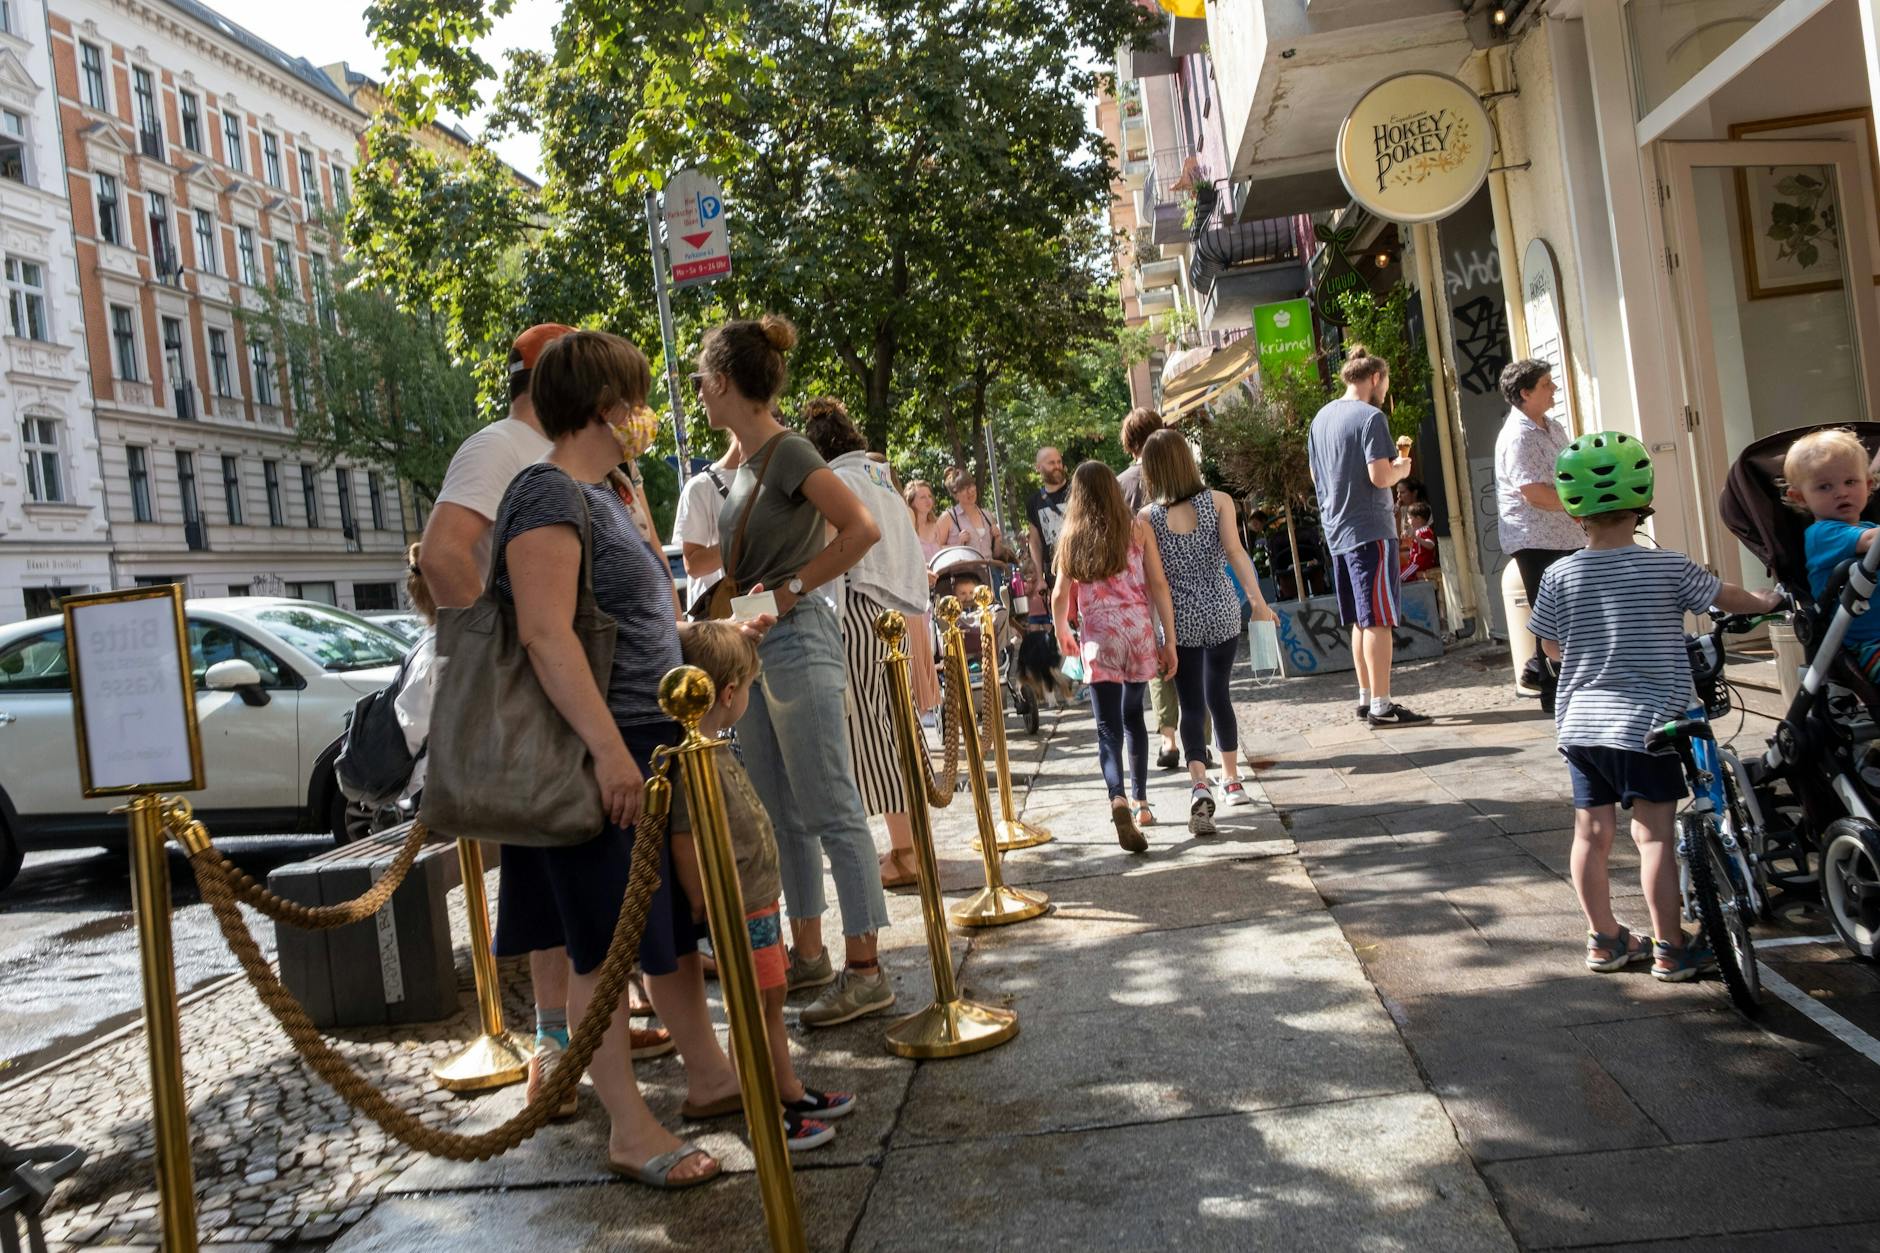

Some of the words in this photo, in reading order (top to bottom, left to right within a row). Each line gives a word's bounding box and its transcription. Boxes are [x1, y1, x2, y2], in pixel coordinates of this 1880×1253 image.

[1373, 109, 1446, 156] HOKEY
[1376, 121, 1453, 193] POKEY
[1326, 271, 1357, 294] LIQUID
[1260, 334, 1312, 355] krümel
